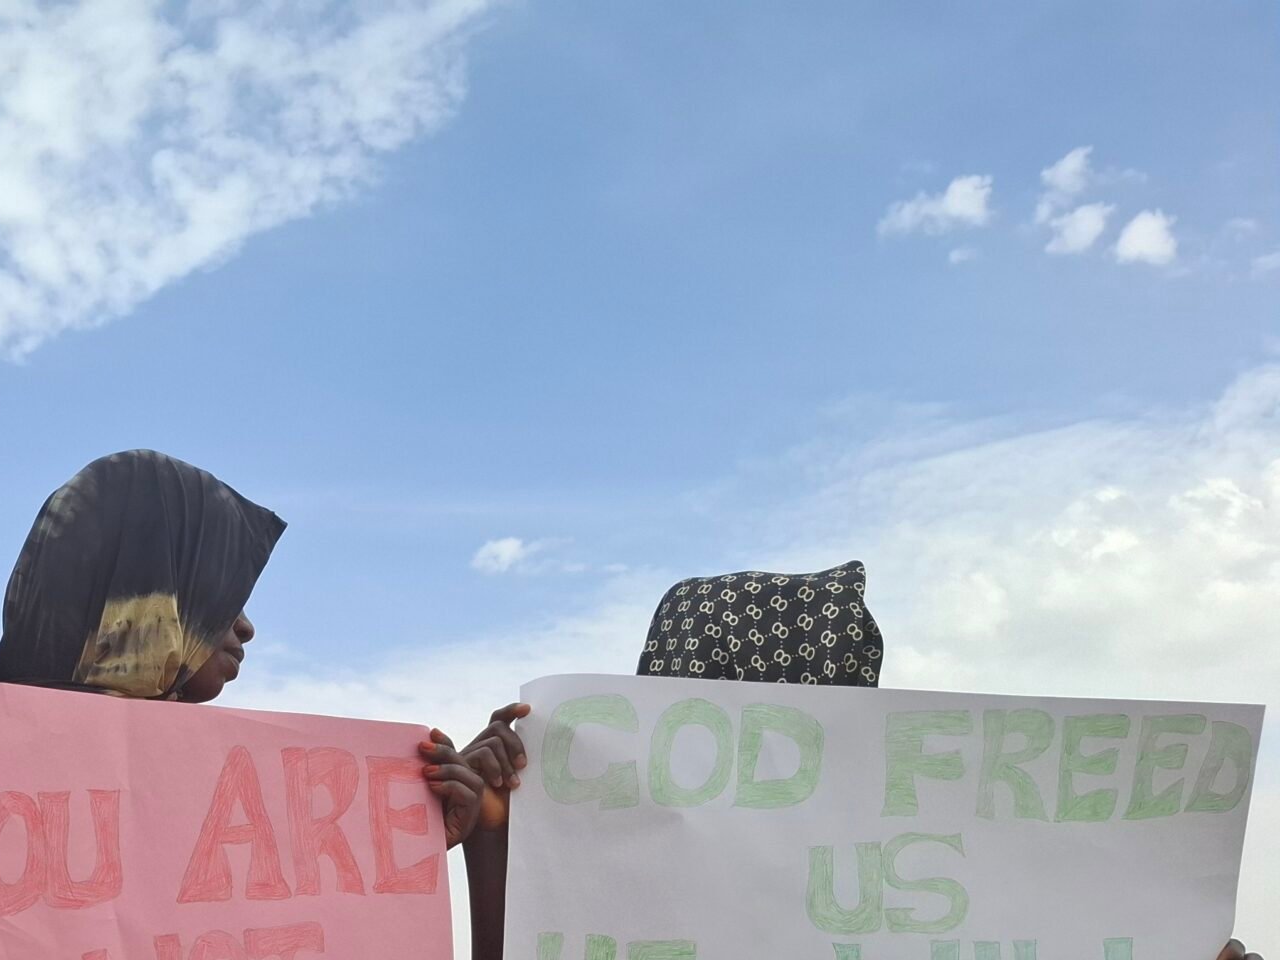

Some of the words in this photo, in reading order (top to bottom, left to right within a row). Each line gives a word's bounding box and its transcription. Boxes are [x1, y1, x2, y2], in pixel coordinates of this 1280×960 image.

[540, 694, 824, 811] GOD
[880, 709, 1252, 823] FREED
[175, 745, 440, 903] ARE
[804, 831, 970, 935] US
